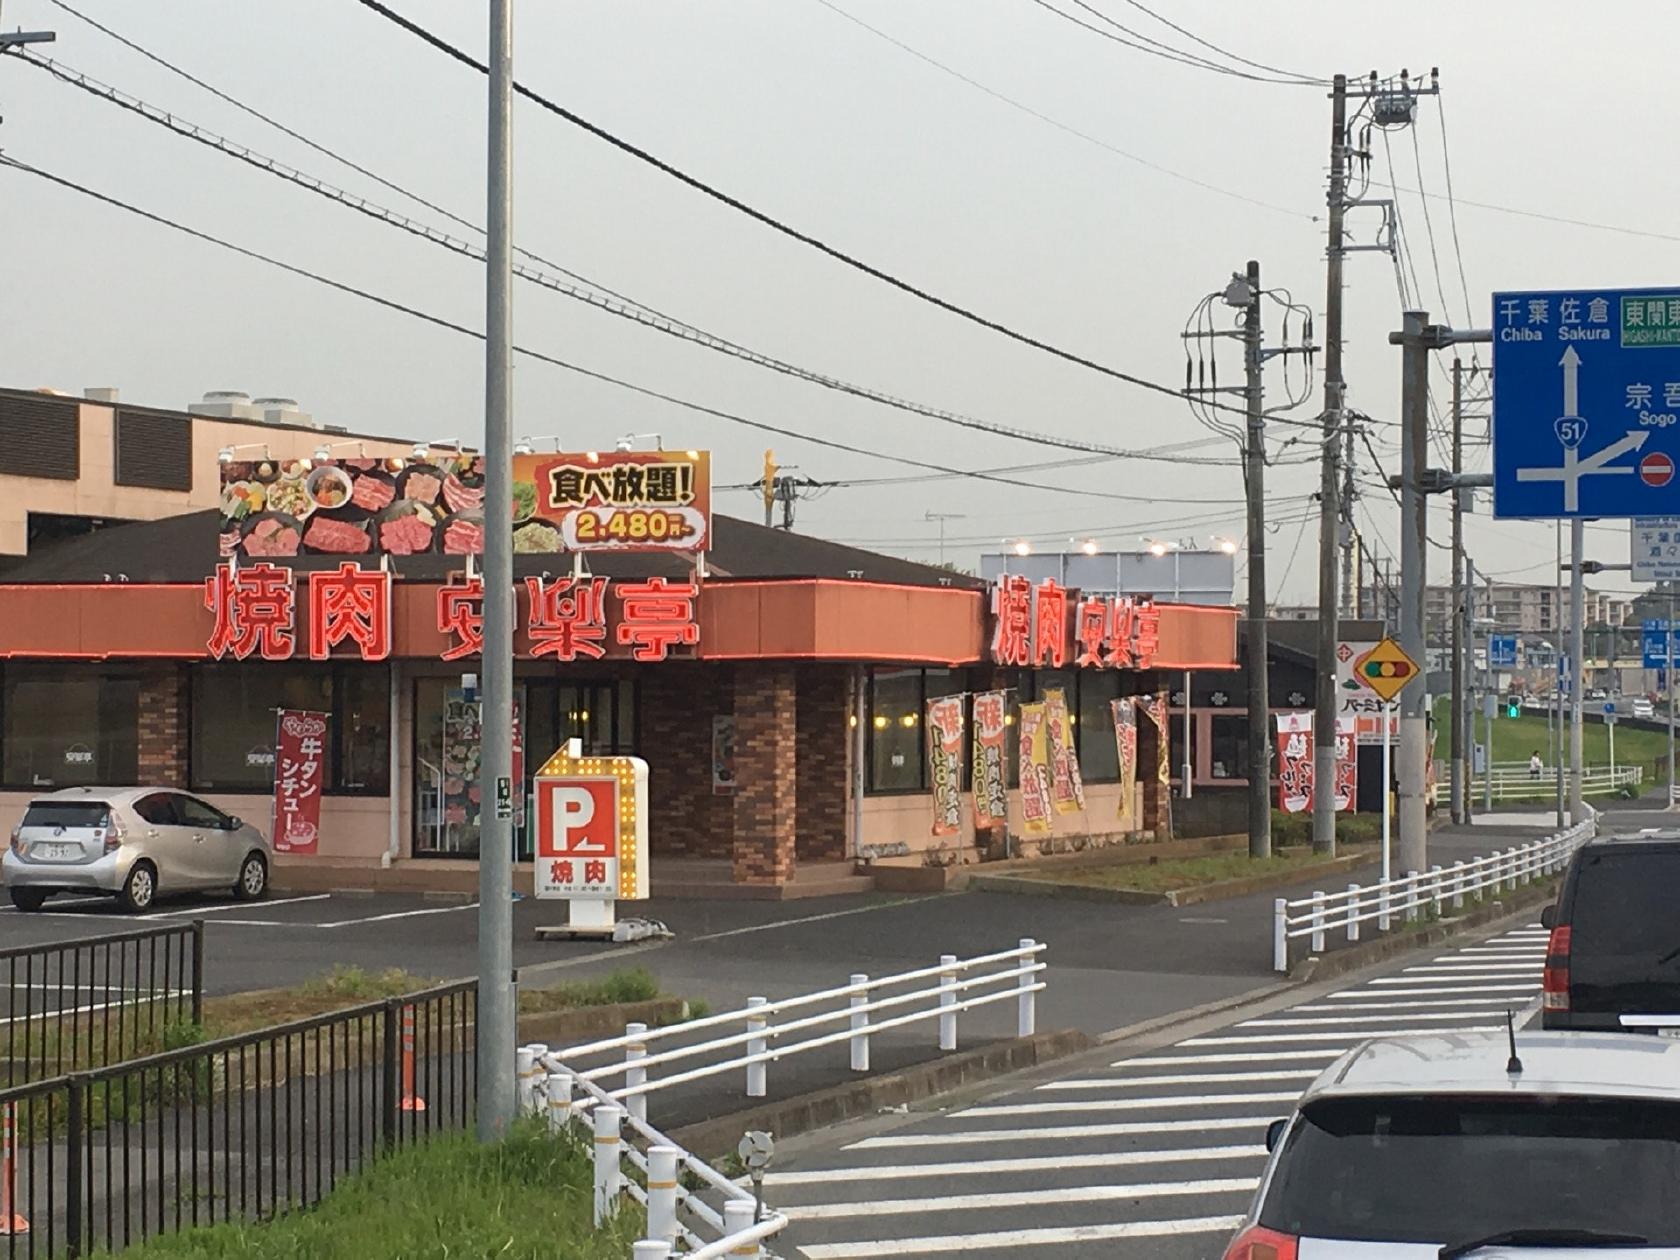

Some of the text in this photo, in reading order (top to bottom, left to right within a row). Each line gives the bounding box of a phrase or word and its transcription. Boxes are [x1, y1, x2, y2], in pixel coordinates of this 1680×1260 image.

[1501, 297, 1609, 325] 千葉 佐倉
[1501, 326, 1611, 342] Chiba Sakura
[1561, 424, 1580, 440] 51
[1639, 410, 1677, 427] Sogo
[551, 464, 695, 503] 食べ放題!
[204, 562, 699, 662] 焼肉 安楽亭
[991, 574, 1067, 669] 焼肉
[300, 737, 322, 798] 牛タン
[281, 758, 300, 831] シチュー
[552, 786, 595, 851] P
[551, 860, 607, 884] 焼肉
